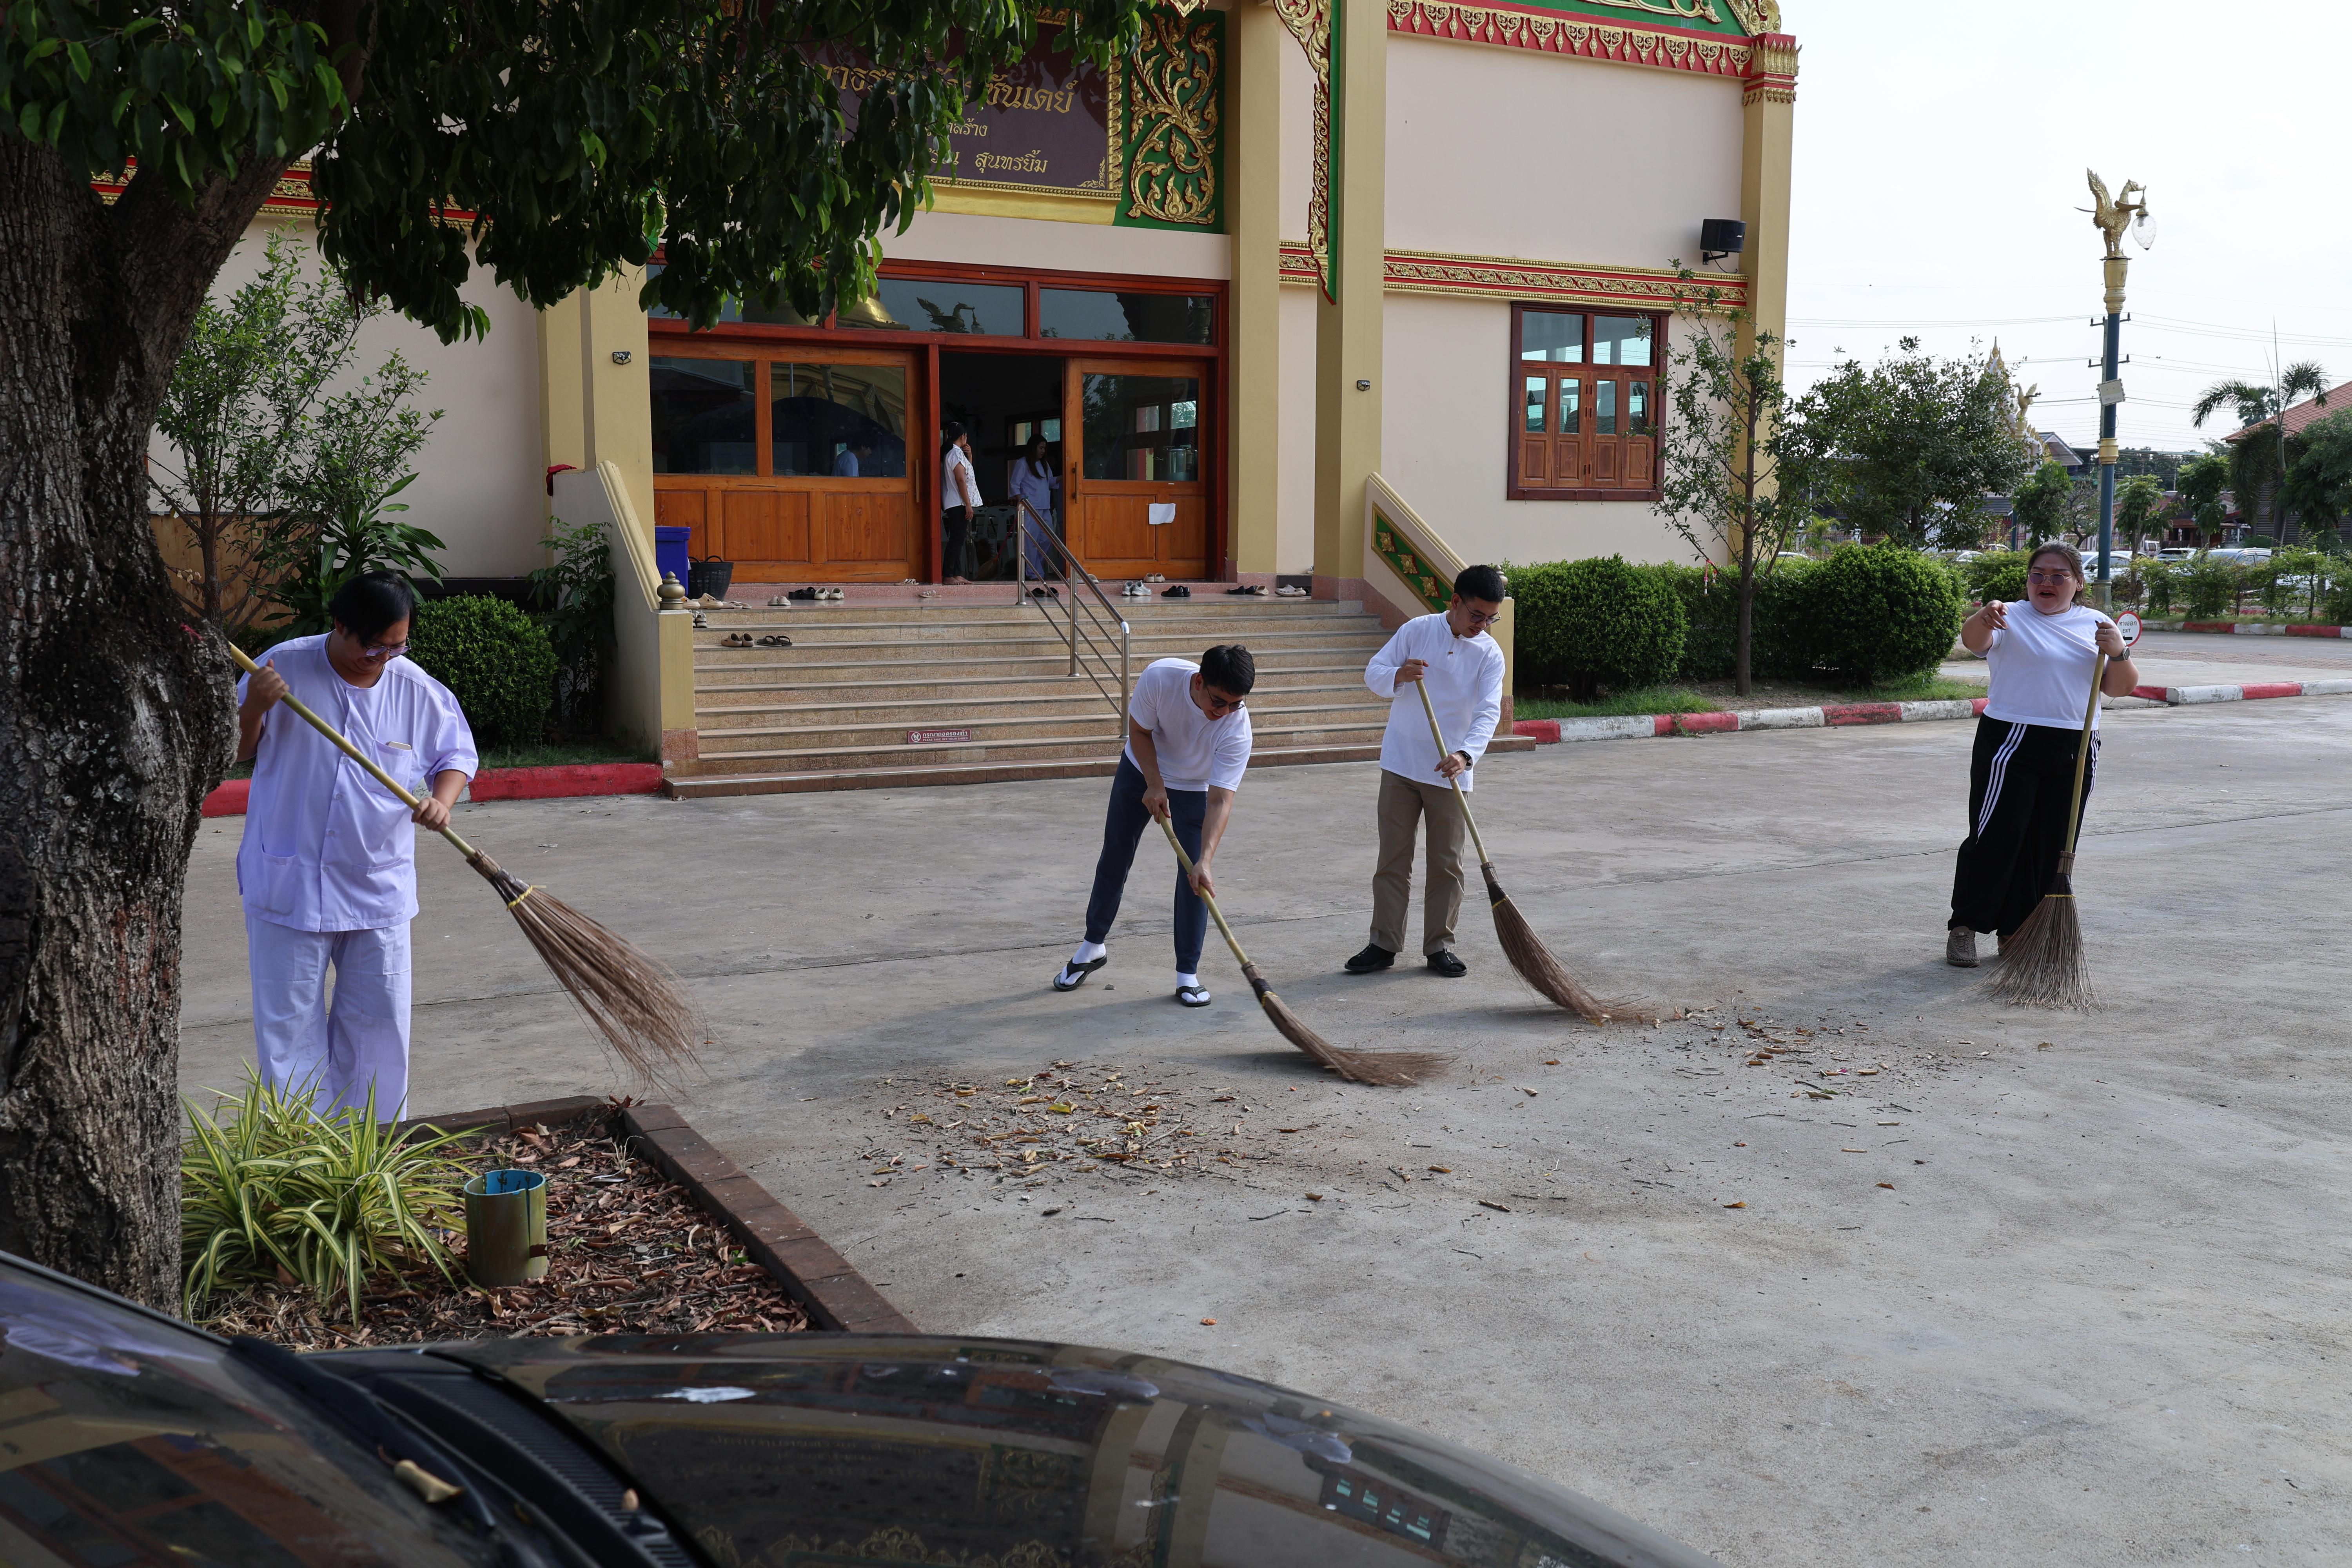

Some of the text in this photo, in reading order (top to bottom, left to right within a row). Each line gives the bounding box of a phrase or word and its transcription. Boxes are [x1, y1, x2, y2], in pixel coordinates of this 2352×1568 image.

[975, 149, 1049, 174] สุนทรยิ้ม
[922, 730, 967, 738] กรุณาถอดรองเท้า
